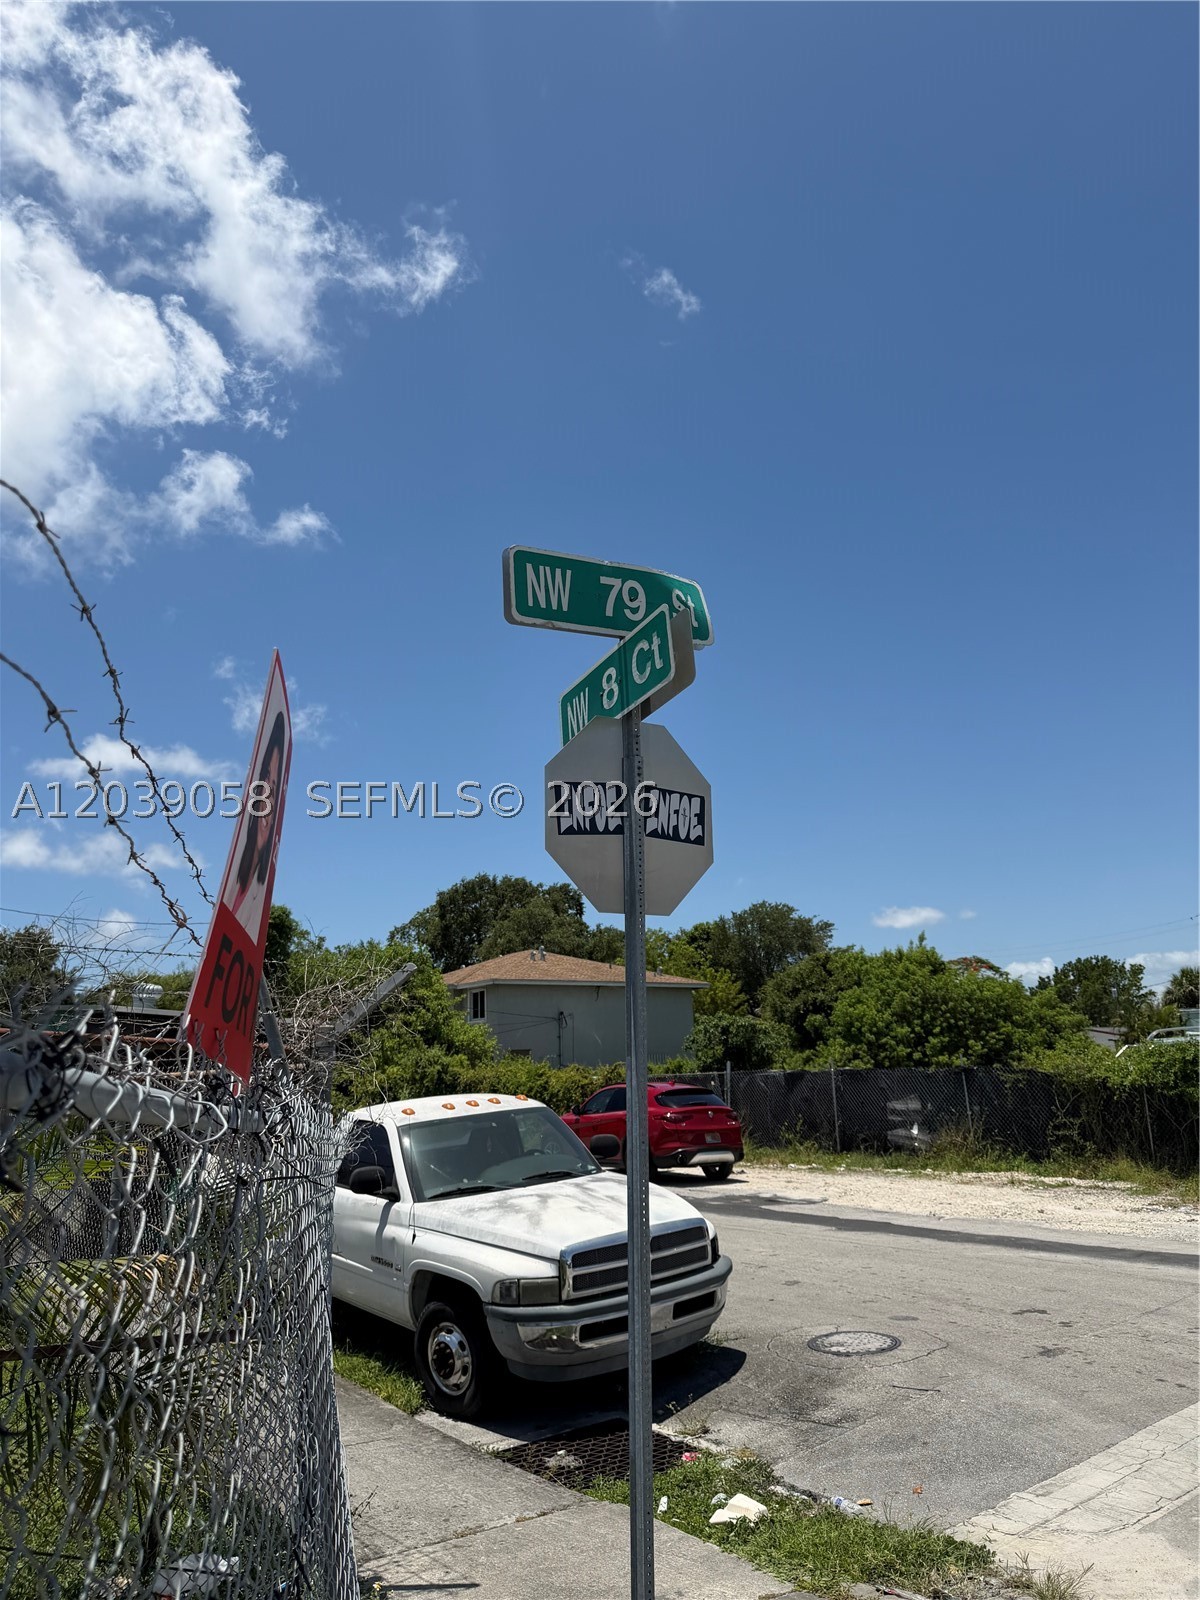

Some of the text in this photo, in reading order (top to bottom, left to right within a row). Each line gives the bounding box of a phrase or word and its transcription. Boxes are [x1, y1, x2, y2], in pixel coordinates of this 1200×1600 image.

[526, 563, 572, 611] NW
[600, 576, 646, 622] 79
[567, 631, 664, 740] NW 8 Ct
[204, 932, 255, 1037] FOR
